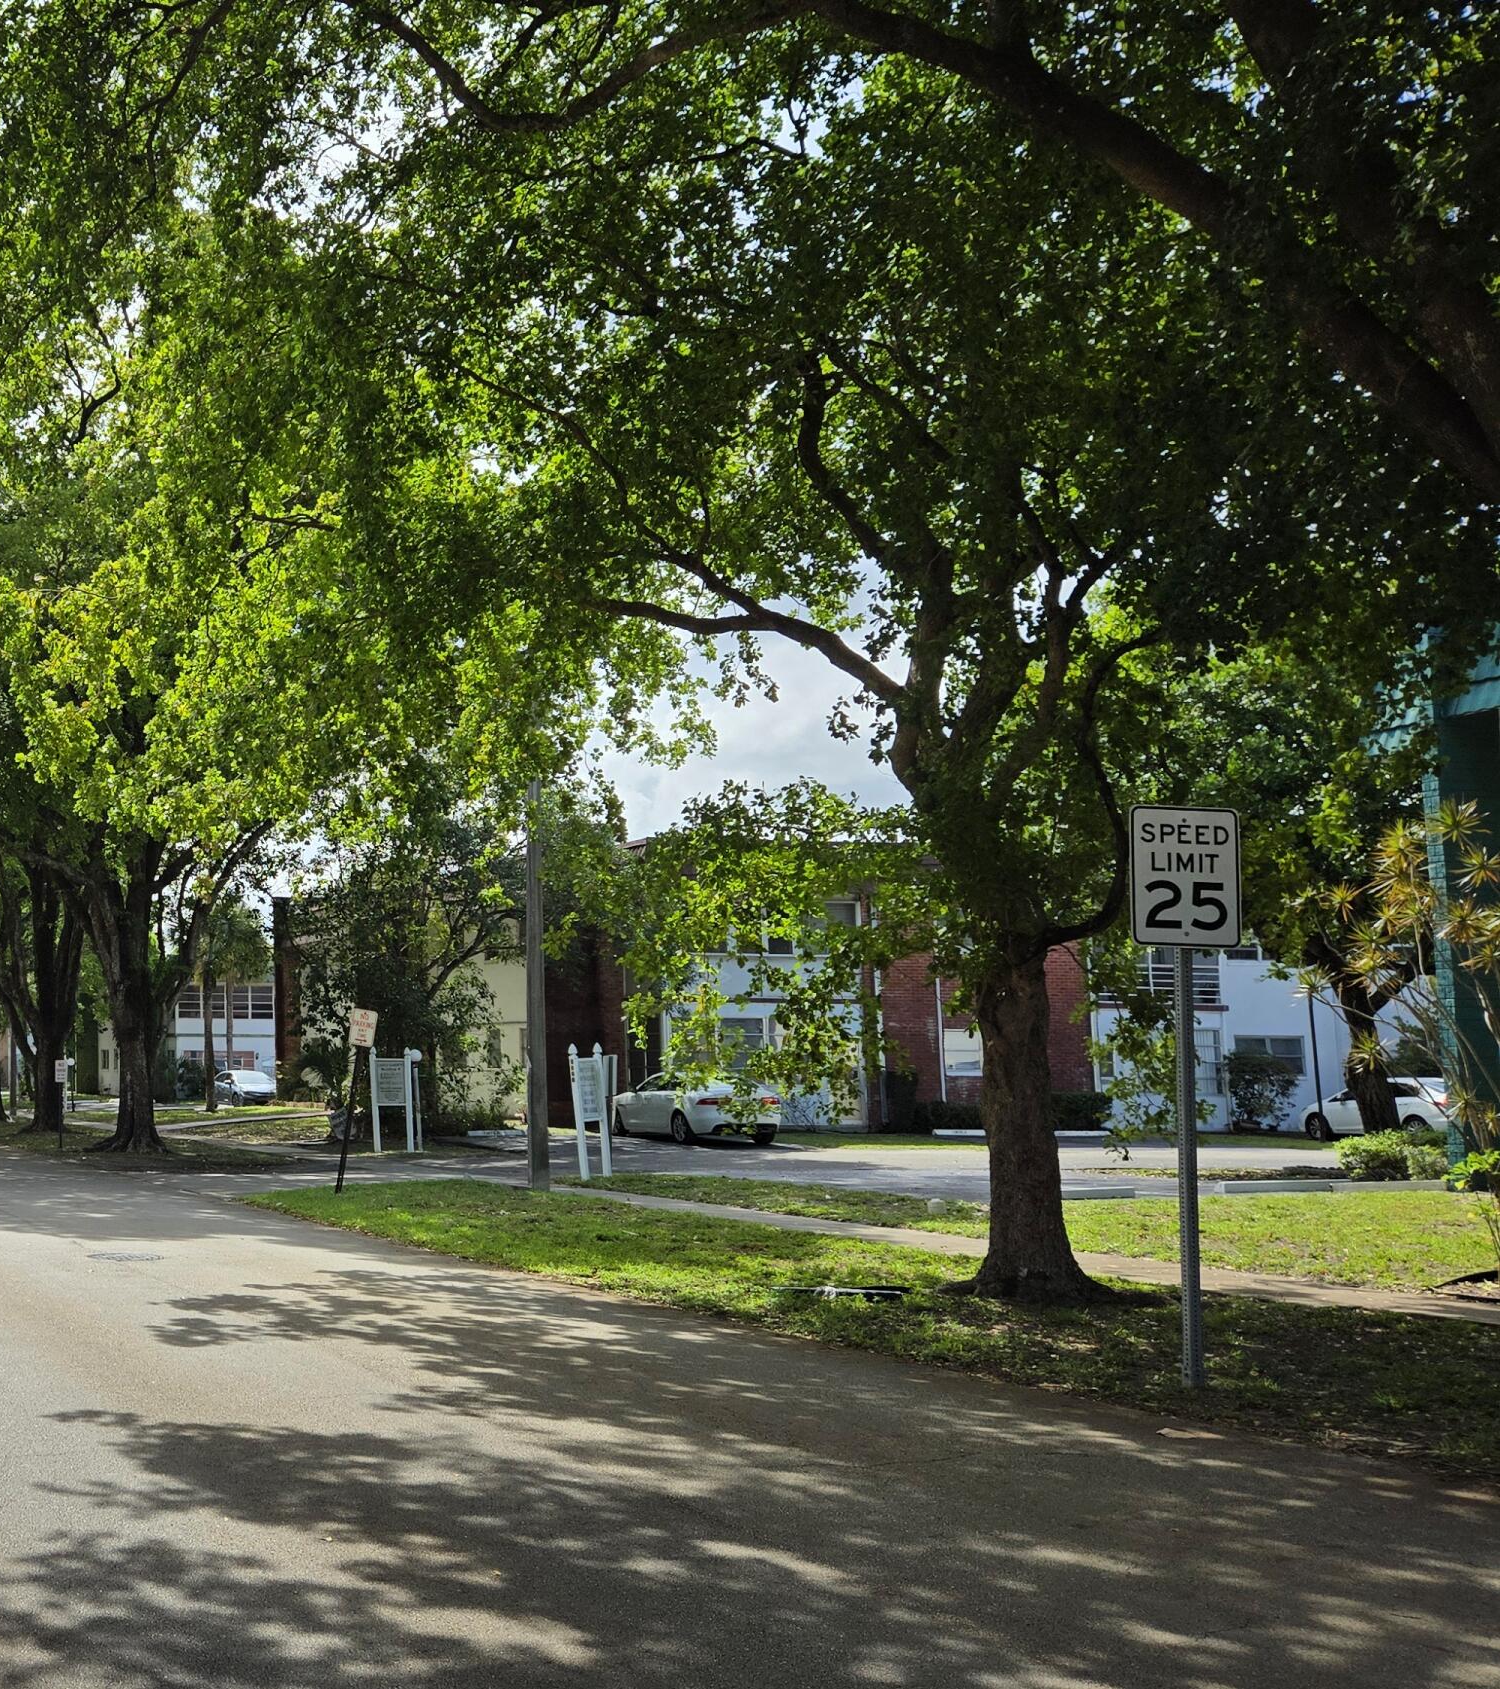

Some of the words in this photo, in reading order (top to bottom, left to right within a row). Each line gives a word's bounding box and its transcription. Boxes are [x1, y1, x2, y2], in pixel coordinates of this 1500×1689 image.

[1140, 822, 1229, 846] SPEED
[1151, 851, 1219, 874] LIMIT
[1144, 880, 1228, 931] 25
[352, 1020, 374, 1029] PARKING
[360, 1012, 369, 1020] NO
